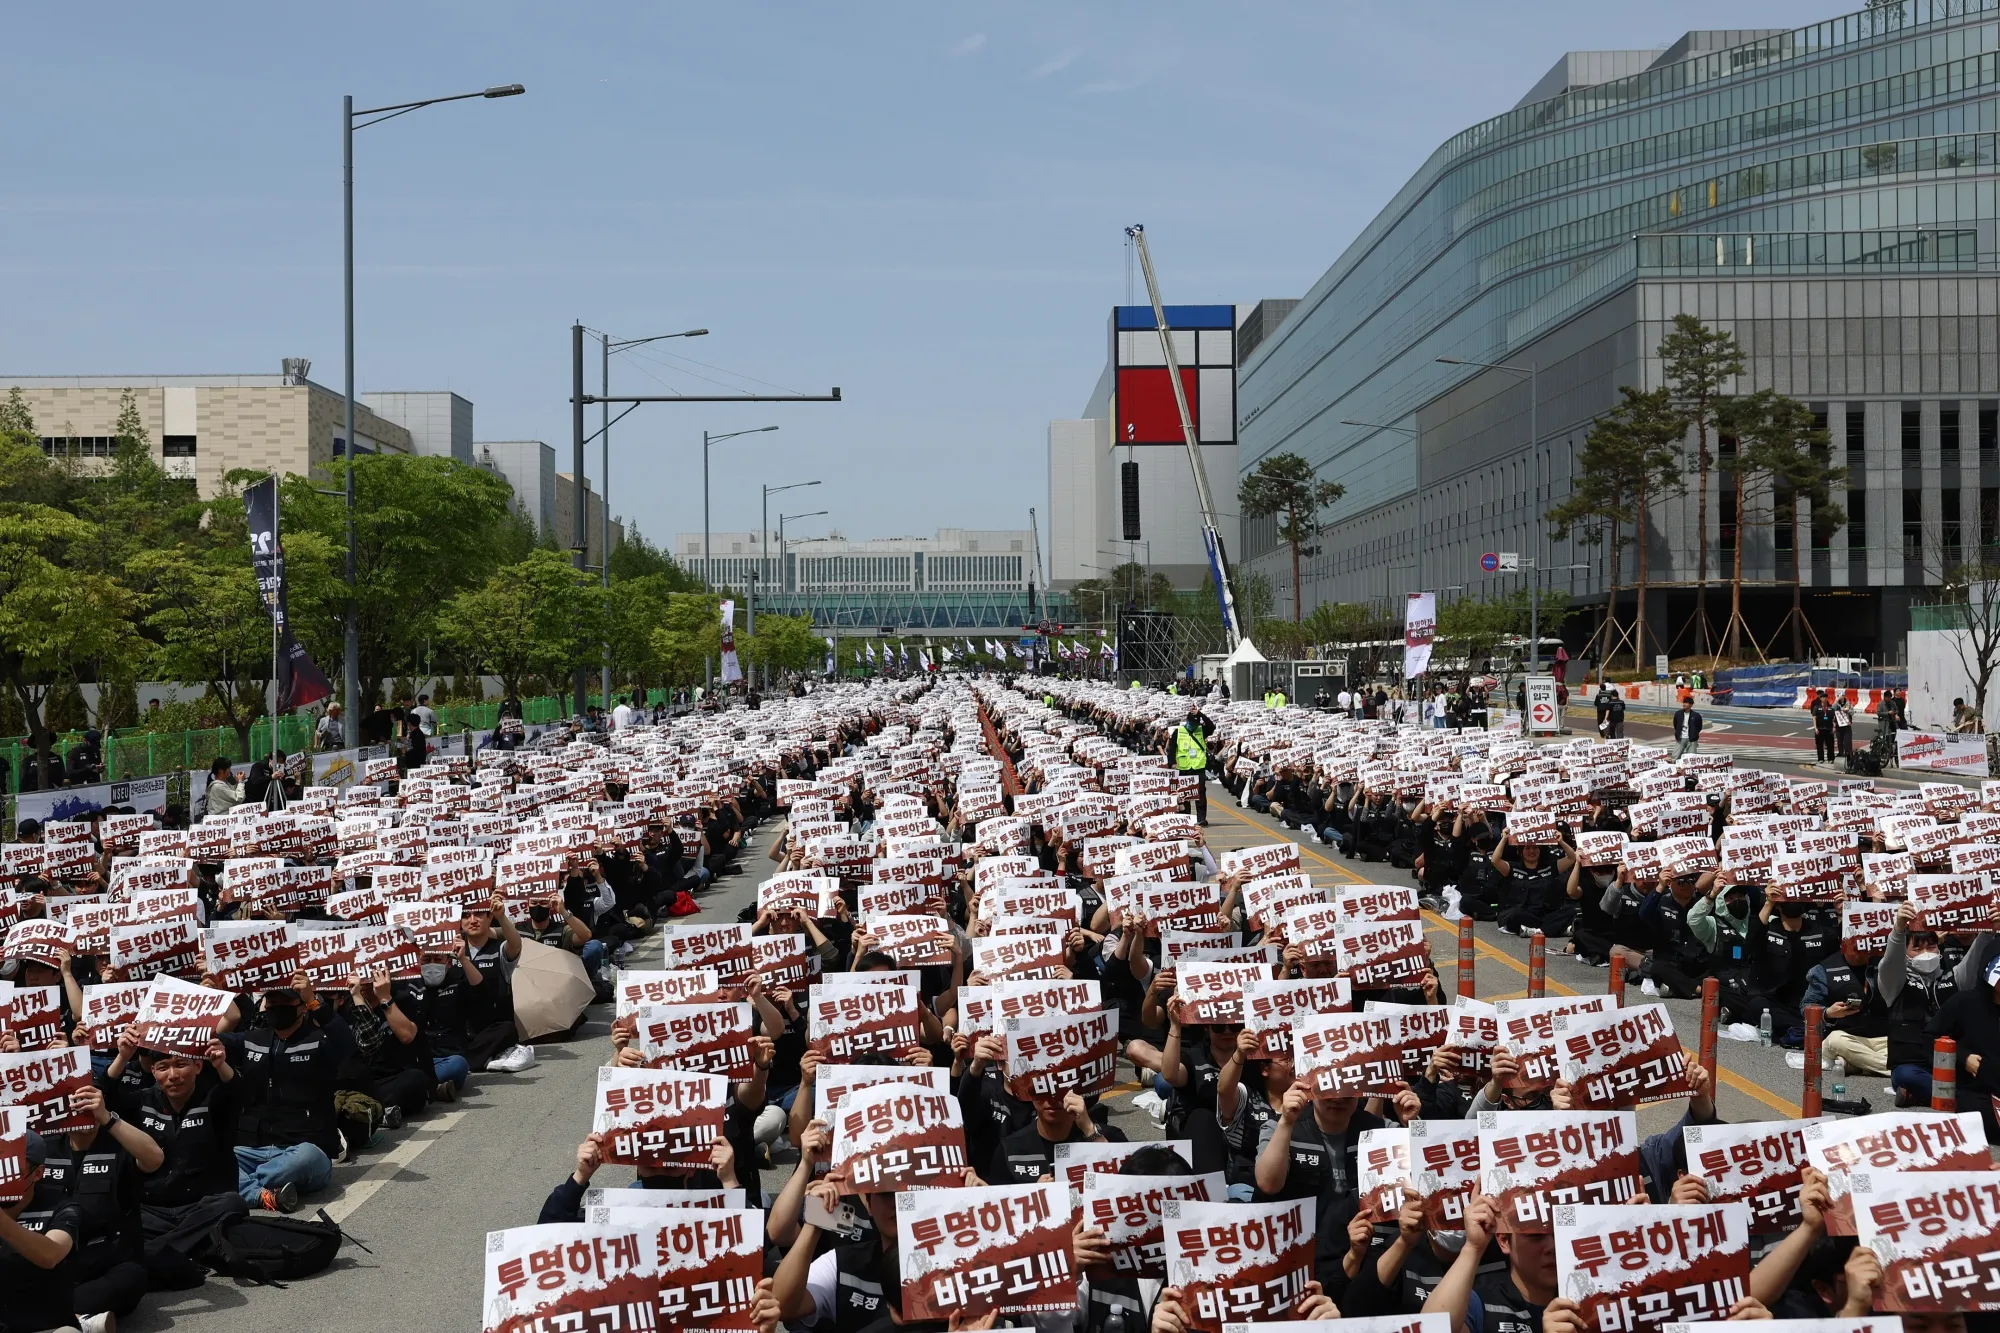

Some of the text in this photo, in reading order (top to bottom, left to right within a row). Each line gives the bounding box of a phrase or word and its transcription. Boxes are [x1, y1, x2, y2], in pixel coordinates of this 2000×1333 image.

[1533, 692, 1550, 701] 입구
[1493, 750, 1520, 764] 투명하게
[1590, 746, 1617, 756] 투명하게
[367, 758, 394, 772] 투명하게
[893, 761, 924, 775] 투명하게
[1135, 756, 1165, 768] 투명하게
[1332, 761, 1360, 773] 투명하게
[1417, 759, 1445, 771] 투명하게
[1683, 756, 1711, 766] 투명하게
[631, 773, 660, 785] 투명하게
[780, 782, 813, 793] 투명하게
[1133, 777, 1166, 790] 투명하게
[1366, 773, 1396, 784] 투명하게
[1523, 774, 1556, 788] 투명하게
[1591, 773, 1621, 787] 투명하게
[1646, 778, 1682, 793] 투명하게
[112, 787, 129, 801] NSEU
[305, 788, 335, 799] 투명하게
[435, 787, 467, 799] 투명하게
[677, 782, 707, 794] 투명하게
[1463, 786, 1501, 799] 투명하게
[1545, 785, 1584, 801] 투명하게
[1792, 784, 1824, 798] 투명하게
[1924, 785, 1960, 797] 투명하게
[289, 801, 322, 814] 투명하게
[961, 794, 997, 808] 투명하게
[1017, 796, 1054, 810] 투명하게
[1128, 800, 1160, 818] 투명하게
[1470, 799, 1505, 809] 바꾸고!!!
[966, 808, 1001, 821] 바꾸고!!!
[1510, 813, 1550, 828] 투명하게
[1633, 803, 1672, 820] 투명하게
[1832, 808, 1869, 821] 투명하게
[47, 823, 86, 838] 투명하게
[110, 815, 148, 832] 투명하게
[255, 819, 296, 837] 투명하게
[472, 818, 513, 835] 투명하게
[551, 814, 593, 830] 투명하게
[888, 820, 931, 837] 투명하게
[1066, 817, 1108, 835] 투명하게
[1150, 816, 1187, 831] 투명하게
[1661, 813, 1704, 830] 투명하게
[1768, 817, 1814, 836] 투명하게
[143, 832, 182, 847] 투명하게
[188, 827, 227, 842] 투명하게
[380, 828, 420, 847] 투명하게
[800, 823, 843, 841] 투명하게
[1517, 830, 1556, 843] 바꾸고!!!
[1910, 825, 1960, 847] 투명하게
[260, 836, 301, 852] 바꾸고!!!
[516, 835, 563, 853] 투명하게
[1581, 834, 1624, 849] 투명하게
[1662, 839, 1709, 859] 투명하게
[1800, 833, 1852, 853] 투명하게
[47, 845, 88, 863] 투명하게
[823, 844, 870, 859] 투명하게
[1130, 843, 1181, 868] 투명하게
[1241, 845, 1293, 871] 투명하게
[51, 862, 93, 878] 바꾸고!!!
[501, 859, 553, 878] 투명하게
[828, 864, 873, 877] 바꾸고!!!
[878, 860, 934, 883] 투명하게
[979, 861, 1027, 882] 투명하게
[1673, 856, 1717, 874] 바꾸고!!!
[1777, 855, 1833, 878] 투명하게
[128, 869, 180, 890] 투명하게
[427, 864, 484, 889] 투명하게
[506, 879, 557, 897] 바꾸고!!!
[763, 880, 813, 898] 투명하게
[1785, 879, 1838, 898] 바꾸고!!!
[1914, 877, 1983, 903] 투명하게
[136, 891, 190, 915] 투명하게
[862, 886, 919, 914] 투명하게
[1003, 891, 1067, 917] 투명하게
[1149, 888, 1212, 911] 투명하게
[1343, 890, 1411, 918] 투명하게
[71, 905, 130, 929] 투명하게
[393, 905, 453, 925] 투명하게
[1157, 912, 1218, 932] 바꾸고!!!
[1924, 905, 1990, 927] 바꾸고!!!
[874, 917, 940, 941] 투명하게
[116, 924, 189, 957] 투명하게
[212, 925, 287, 960] 투명하게
[671, 926, 743, 957] 투명하게
[1342, 923, 1415, 956] 투명하게
[1768, 936, 1784, 945] 투쟁
[980, 936, 1052, 967] 투명하게
[128, 951, 195, 981] 바꾸고!!!
[225, 956, 297, 988] 바꾸고!!!
[1354, 955, 1424, 984] 바꾸고!!!
[625, 973, 706, 1004] 투명하게
[1185, 967, 1262, 993] 투명하게
[151, 992, 223, 1017] 투명하게
[819, 988, 907, 1024] 투명하게
[1001, 983, 1089, 1018] 투명하게
[1252, 981, 1340, 1020] 투명하게
[648, 1006, 740, 1047] 투명하게
[145, 1026, 211, 1047] 바꾸고!!!
[830, 1025, 917, 1056] 바꾸고!!!
[1016, 1013, 1108, 1061] 투명하게
[1302, 1017, 1392, 1056] 투명하게
[1565, 1007, 1666, 1065] 투명하게
[247, 1050, 263, 1062] 투쟁
[290, 1053, 310, 1063] SELU
[121, 1075, 141, 1085] 투쟁
[1031, 1053, 1113, 1097] 바꾸고!!!
[1317, 1059, 1402, 1092] 바꾸고!!!
[1587, 1051, 1685, 1102] 바꾸고!!!
[606, 1078, 711, 1117] 투명하게
[143, 1117, 166, 1131] 투쟁
[181, 1118, 204, 1129] SELU
[844, 1095, 950, 1142] 투명하게
[615, 1124, 717, 1158] 바꾸고!!!
[1493, 1116, 1624, 1173] 투명하게
[1822, 1118, 1966, 1176] 투명하게
[83, 1163, 109, 1174] SELU
[853, 1145, 965, 1184] 바꾸고!!!
[1295, 1153, 1319, 1166] 투쟁
[42, 1168, 64, 1180] 투쟁
[1014, 1164, 1040, 1177] 투쟁
[911, 1189, 1051, 1256] 투명하게
[1177, 1205, 1302, 1266] 투명하게
[1571, 1209, 1728, 1277] 투명하게
[498, 1233, 641, 1301] 투명하게
[934, 1249, 1071, 1307] 바꾸고!!!
[849, 1292, 879, 1310] 투쟁
[1197, 1265, 1311, 1322] 바꾸고!!!
[1000, 1302, 1076, 1313] 삼성전자노동조합 공동투쟁본부
[1596, 1276, 1744, 1333] 바꾸고!!!
